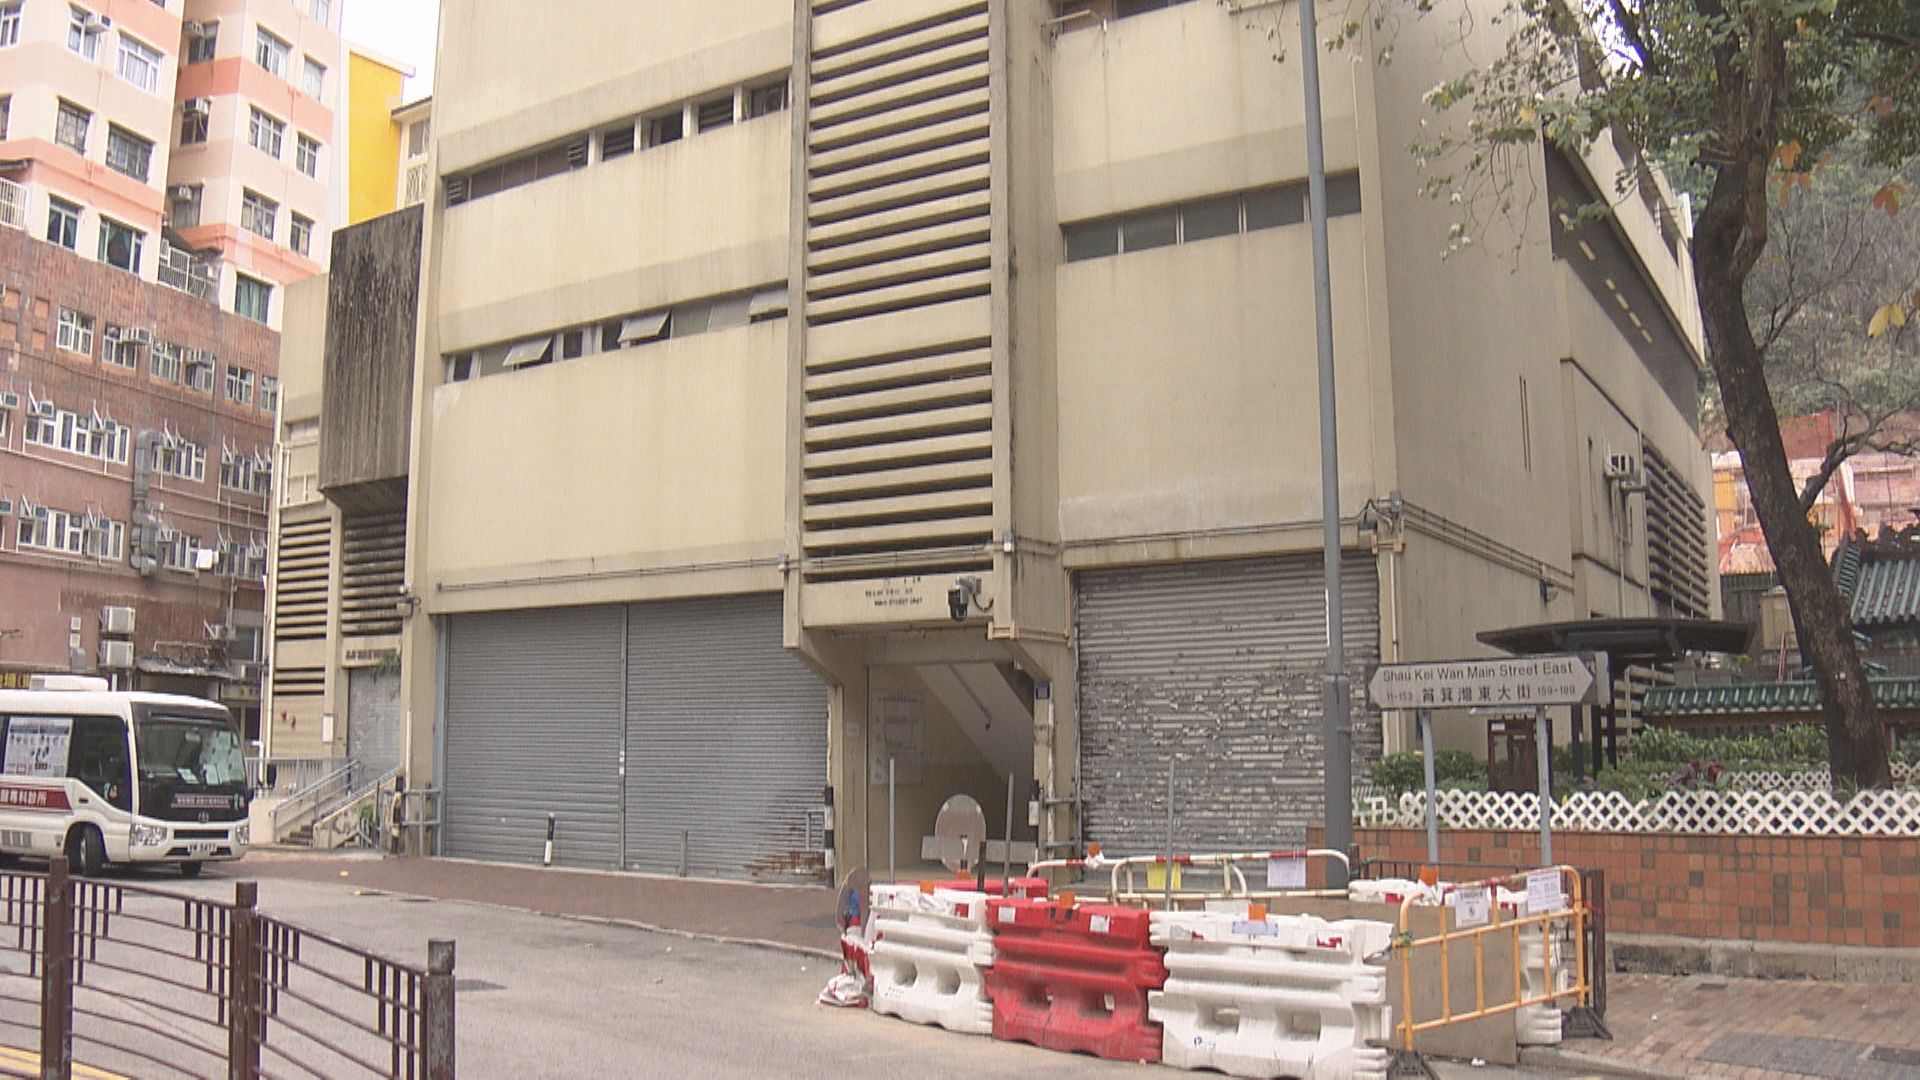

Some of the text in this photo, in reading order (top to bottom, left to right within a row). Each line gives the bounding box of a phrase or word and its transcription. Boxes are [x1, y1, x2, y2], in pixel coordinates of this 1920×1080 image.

[1383, 661, 1573, 682] Shau Kei Wan Main Street East
[1422, 684, 1531, 703] 筲箕灣東大街
